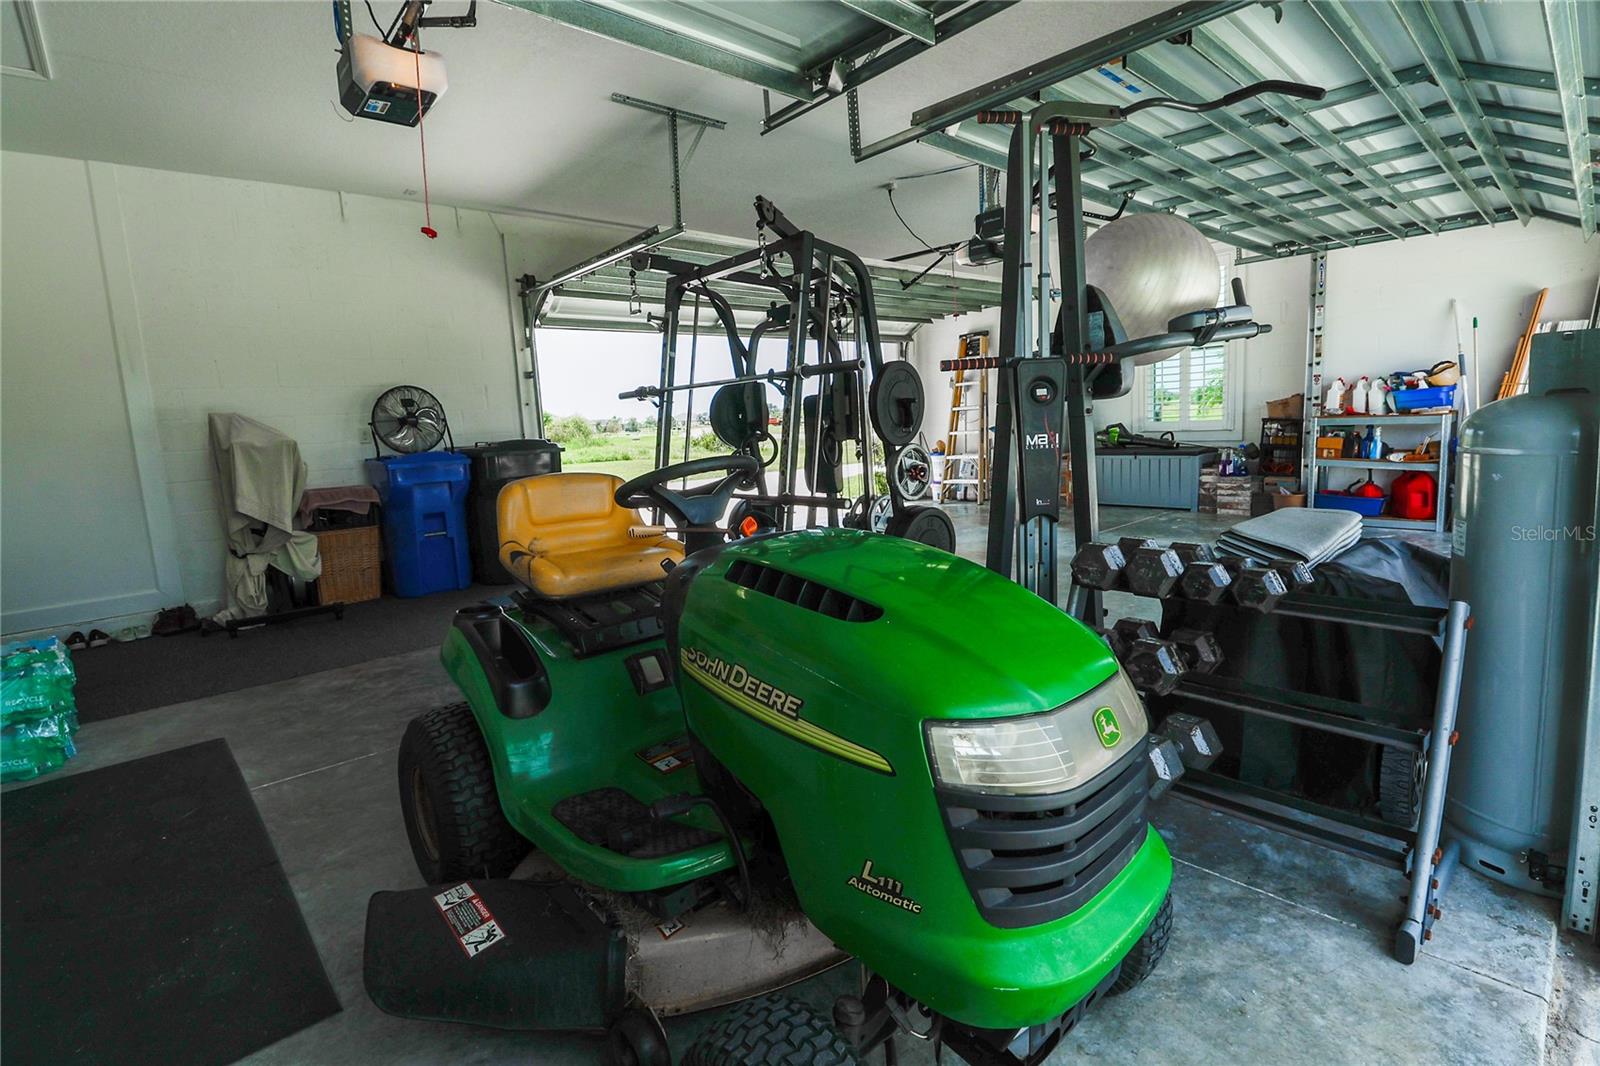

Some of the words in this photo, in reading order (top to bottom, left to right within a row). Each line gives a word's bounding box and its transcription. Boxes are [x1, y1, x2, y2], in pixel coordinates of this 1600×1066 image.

[687, 647, 730, 681] JOHN
[728, 664, 802, 718] DEERE
[847, 877, 922, 913] Automatic
[862, 860, 902, 894] L111
